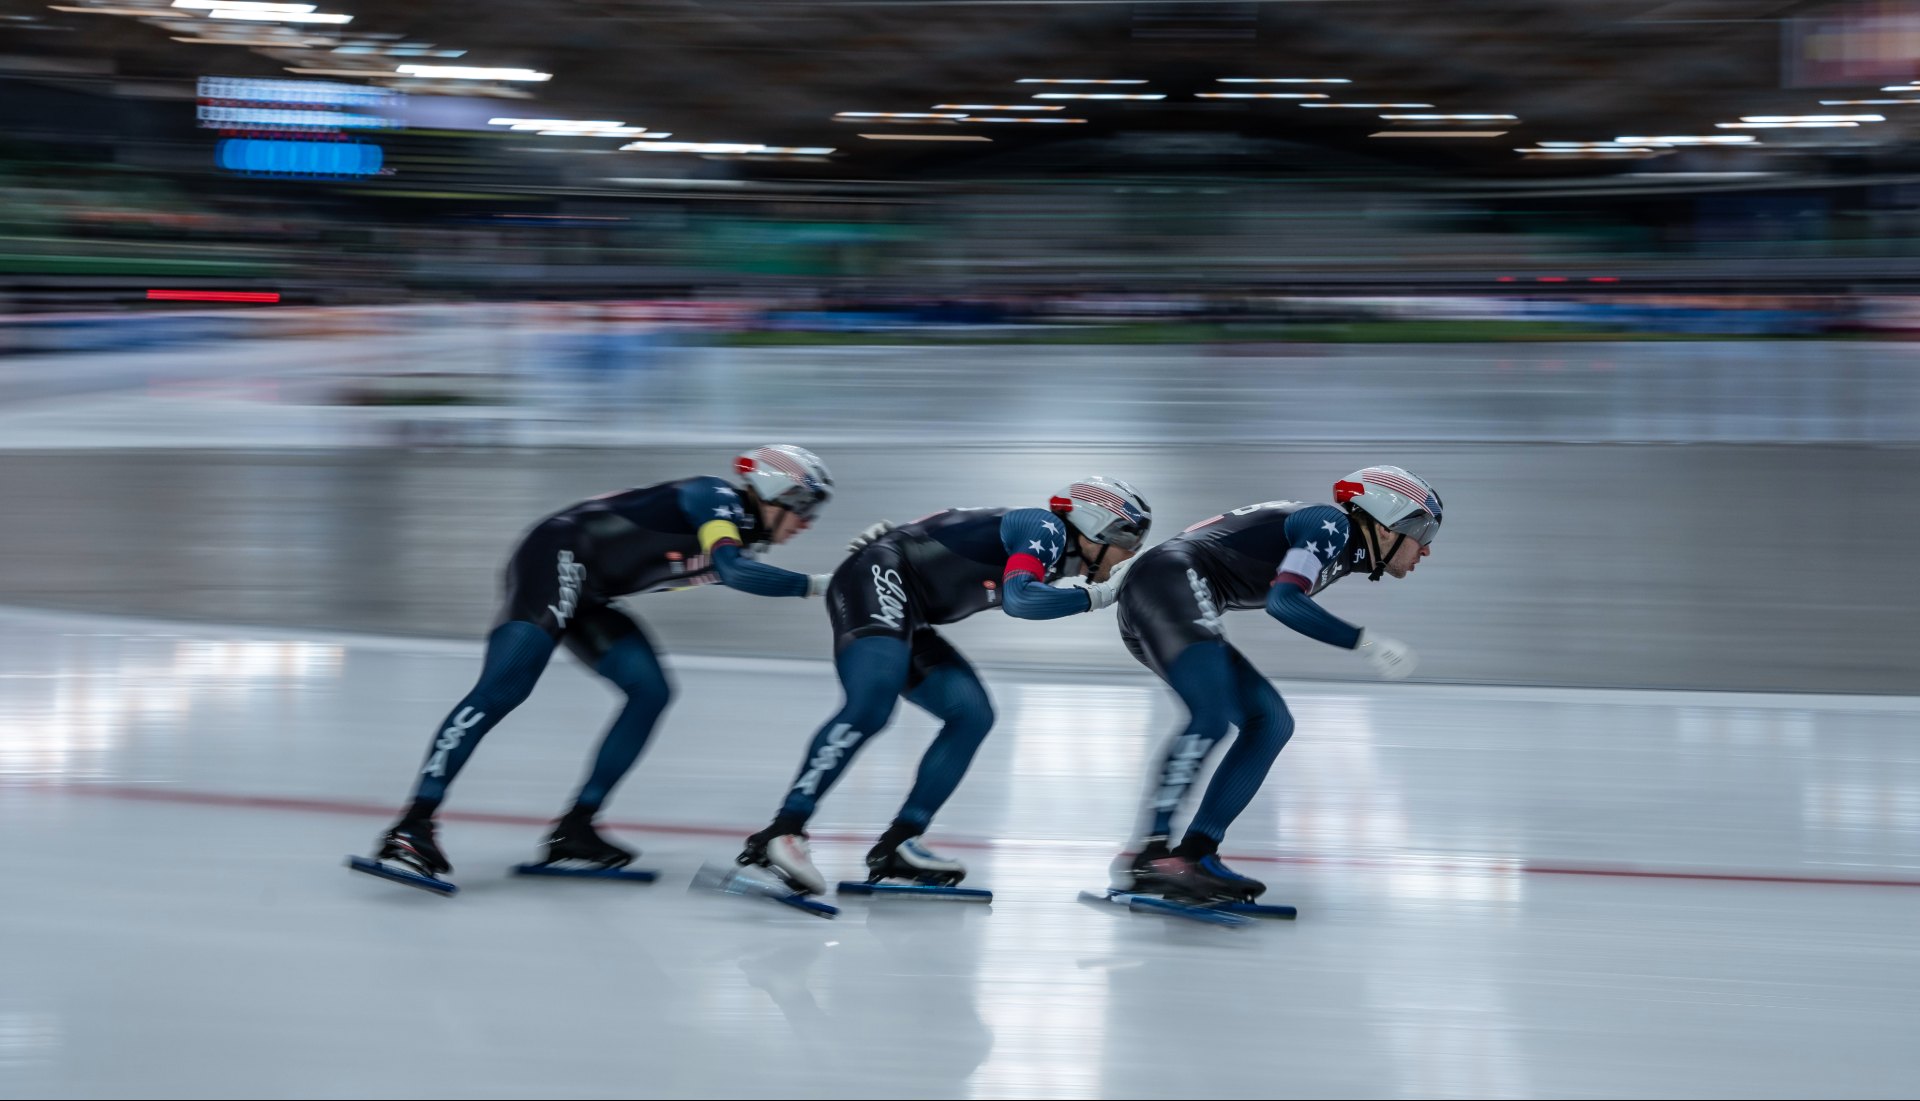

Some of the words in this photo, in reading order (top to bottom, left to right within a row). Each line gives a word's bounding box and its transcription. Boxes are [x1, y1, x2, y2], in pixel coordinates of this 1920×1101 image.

[870, 564, 908, 629] Lilly
[421, 705, 486, 778] USA
[793, 722, 863, 795] USA
